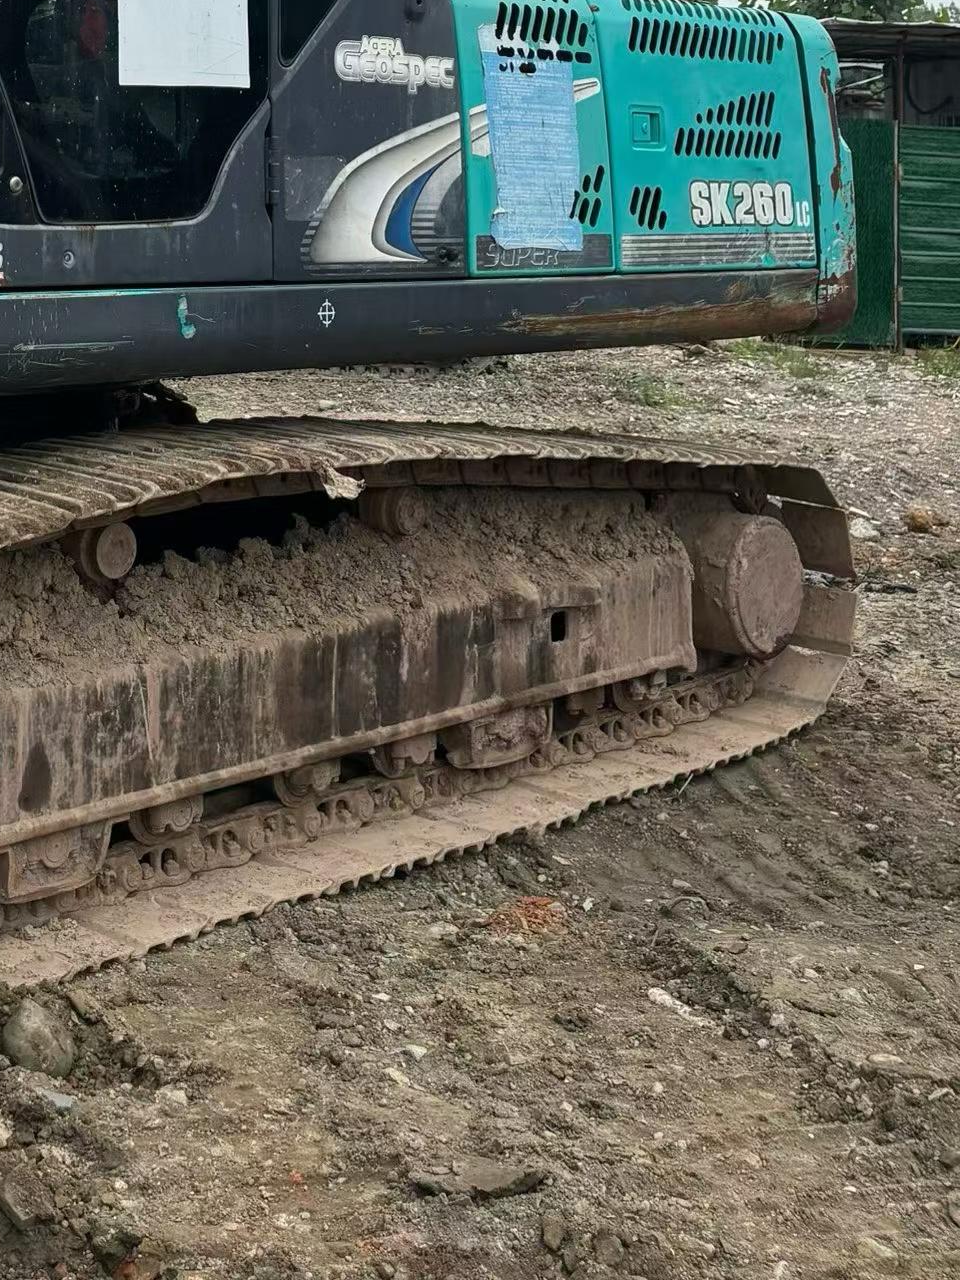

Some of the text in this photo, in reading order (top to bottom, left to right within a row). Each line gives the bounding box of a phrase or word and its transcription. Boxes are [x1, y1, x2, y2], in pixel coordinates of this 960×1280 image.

[361, 35, 405, 56] ACERA
[689, 180, 810, 227] SK260 LC
